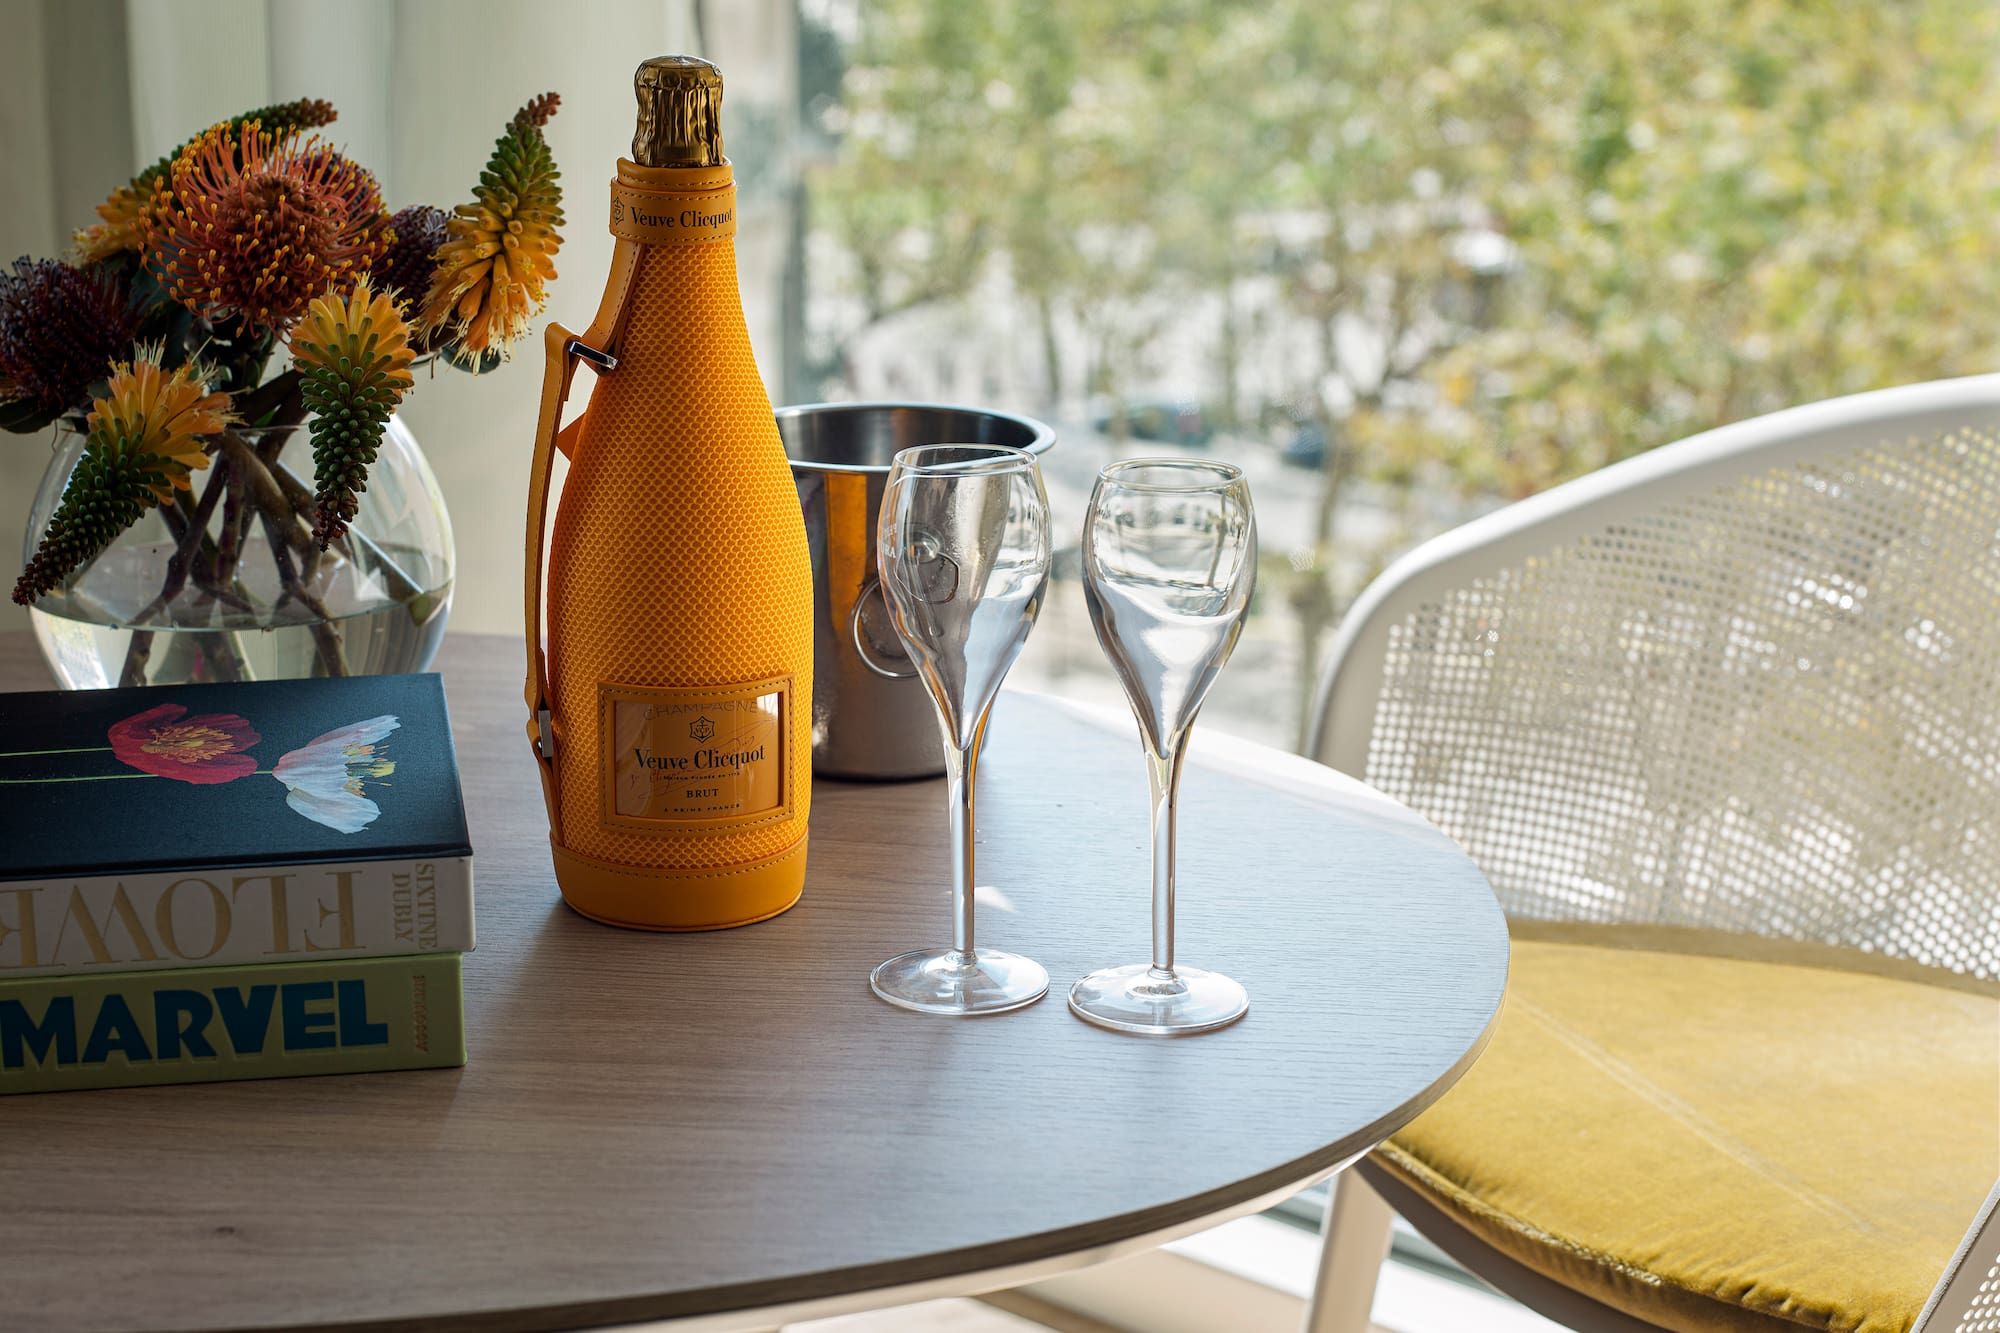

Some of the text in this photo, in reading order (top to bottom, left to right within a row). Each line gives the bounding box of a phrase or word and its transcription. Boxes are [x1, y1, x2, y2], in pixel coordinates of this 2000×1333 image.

[630, 206, 733, 229] Veuve Clicquot
[634, 745, 765, 769] Veuve Clicquot
[686, 788, 719, 798] BRUT
[392, 872, 414, 944] DUBLY
[416, 862, 438, 950] SIXTINE
[0, 980, 389, 1067] MARVEL
